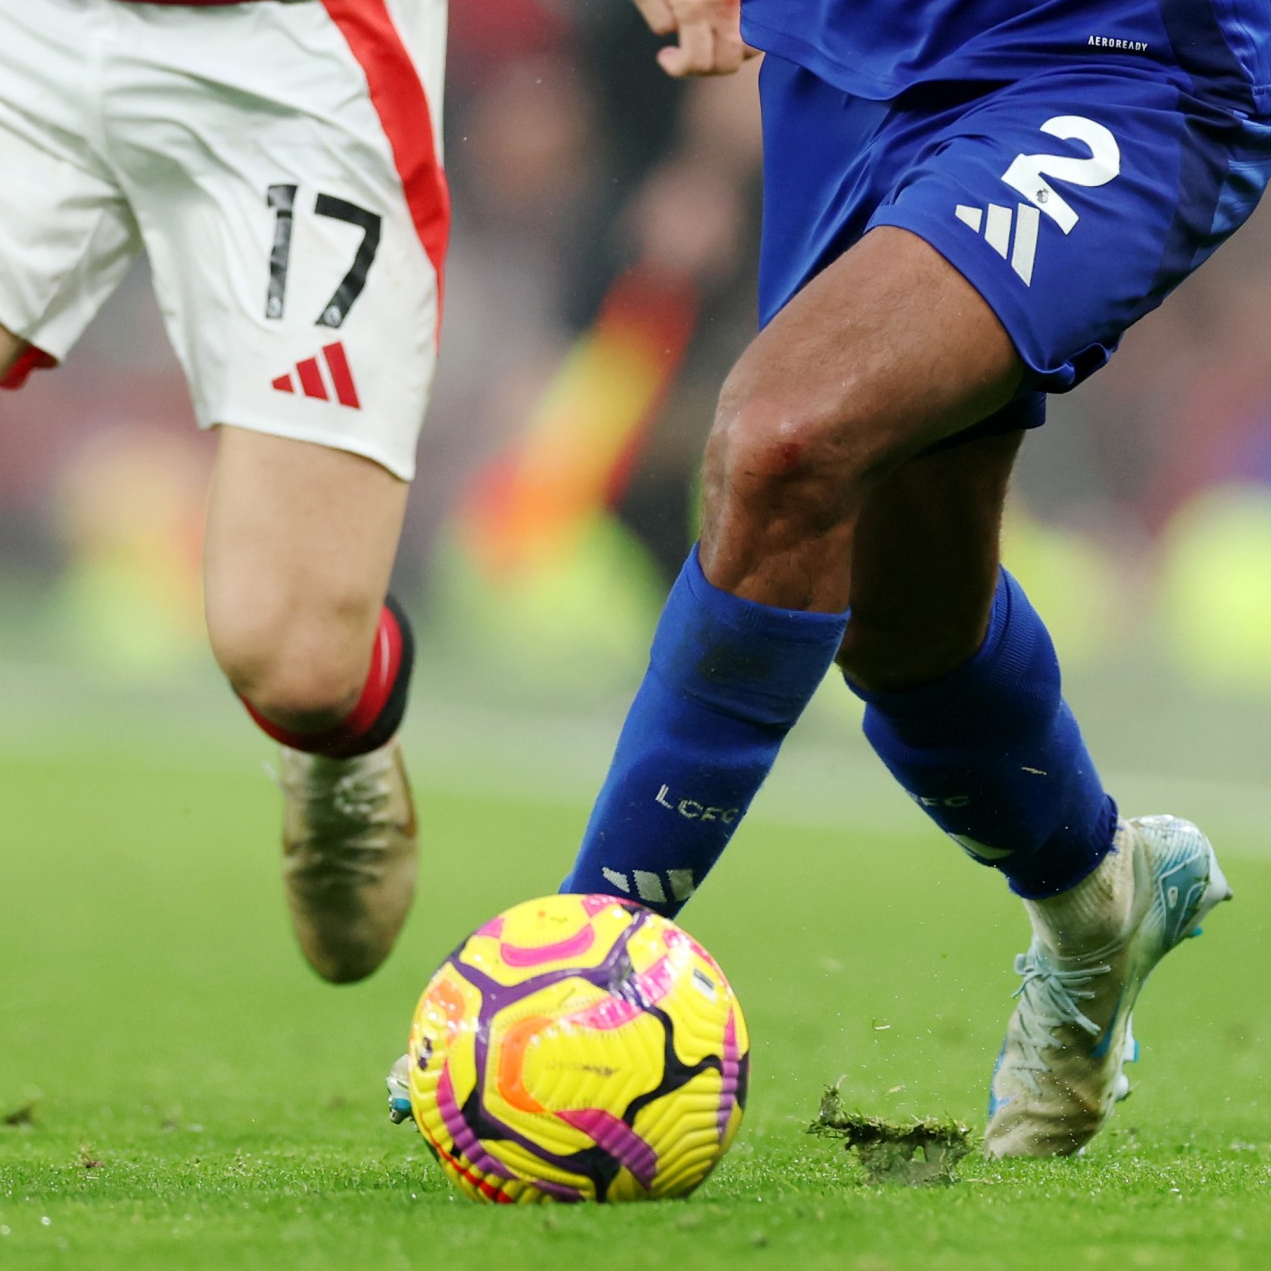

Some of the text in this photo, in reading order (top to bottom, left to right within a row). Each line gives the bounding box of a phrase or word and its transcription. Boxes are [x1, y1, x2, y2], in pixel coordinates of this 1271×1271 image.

[1088, 35, 1148, 52] AEROREADY
[1000, 114, 1121, 236] 2
[265, 184, 383, 329] 17
